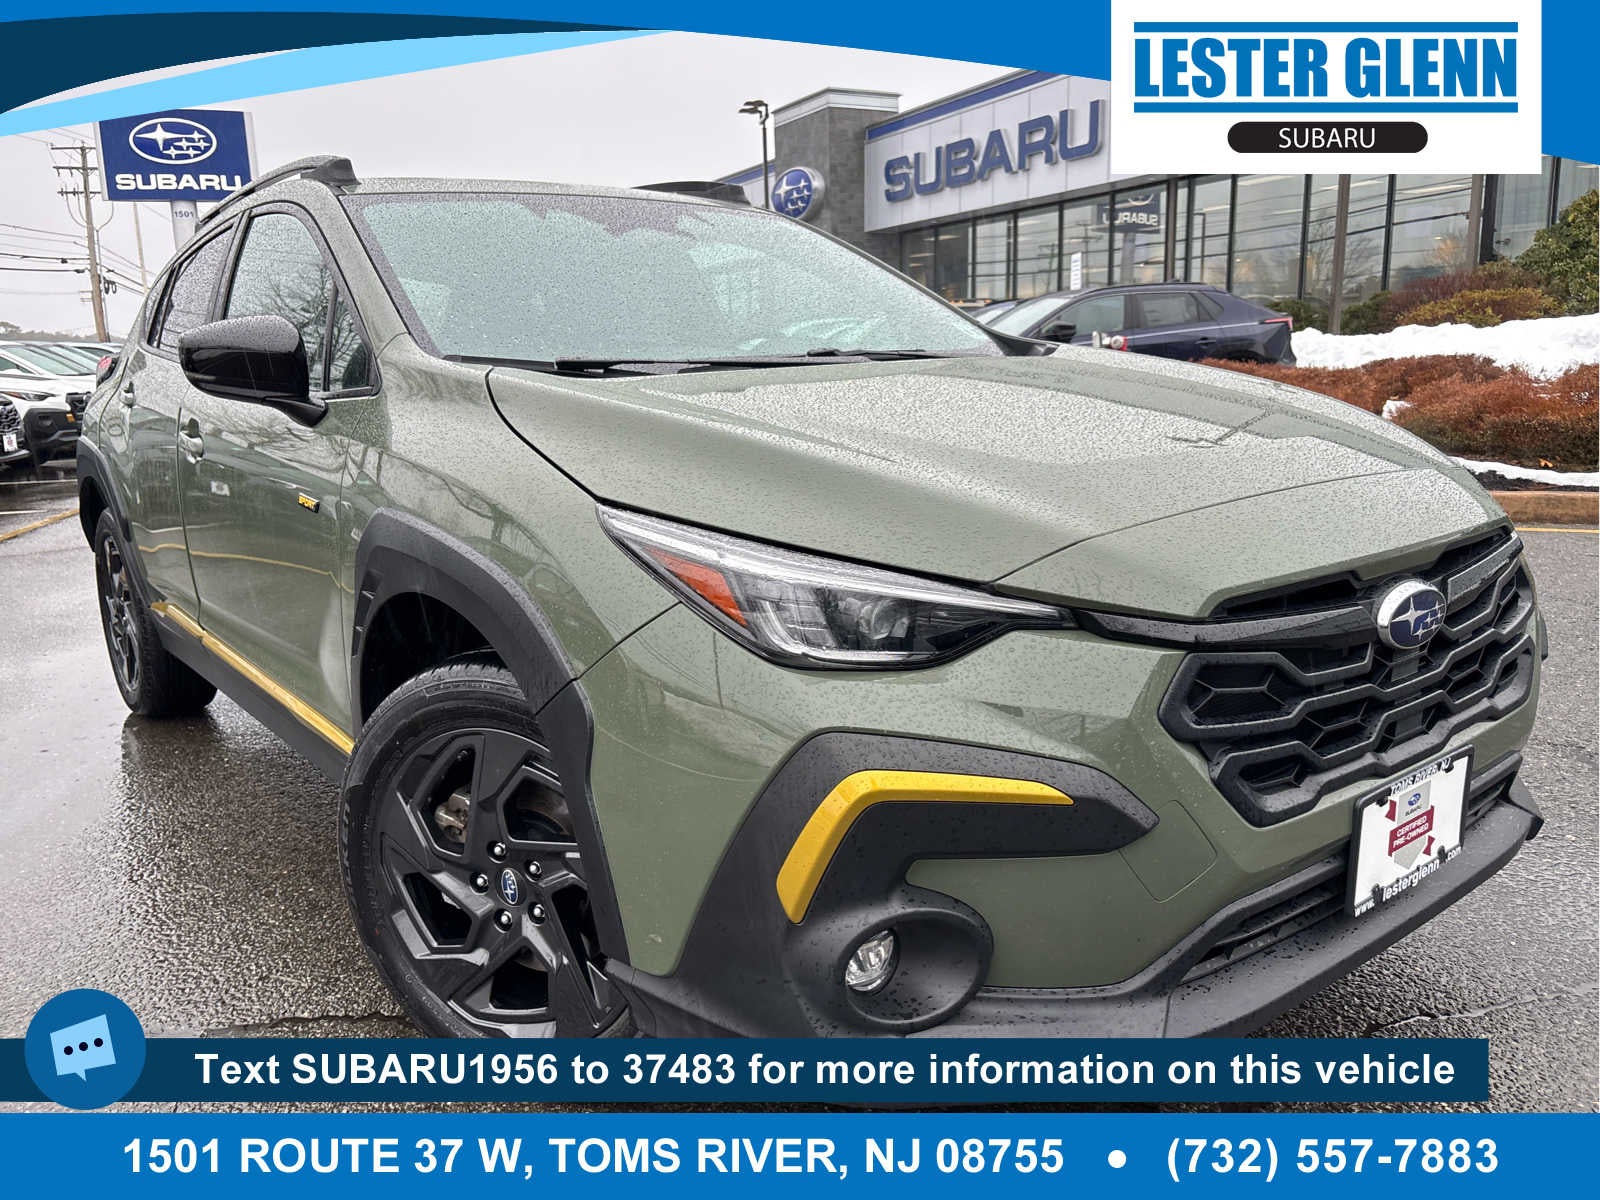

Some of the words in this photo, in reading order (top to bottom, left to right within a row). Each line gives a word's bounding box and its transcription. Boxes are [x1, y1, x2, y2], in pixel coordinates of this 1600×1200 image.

[884, 99, 1105, 203] SUBARU
[115, 173, 242, 191] SUBARU
[174, 210, 194, 218] 1501
[1392, 823, 1429, 849] PRE-OWNED
[1396, 815, 1427, 837] CERTIFIED
[1382, 858, 1440, 903] lesterglenn
